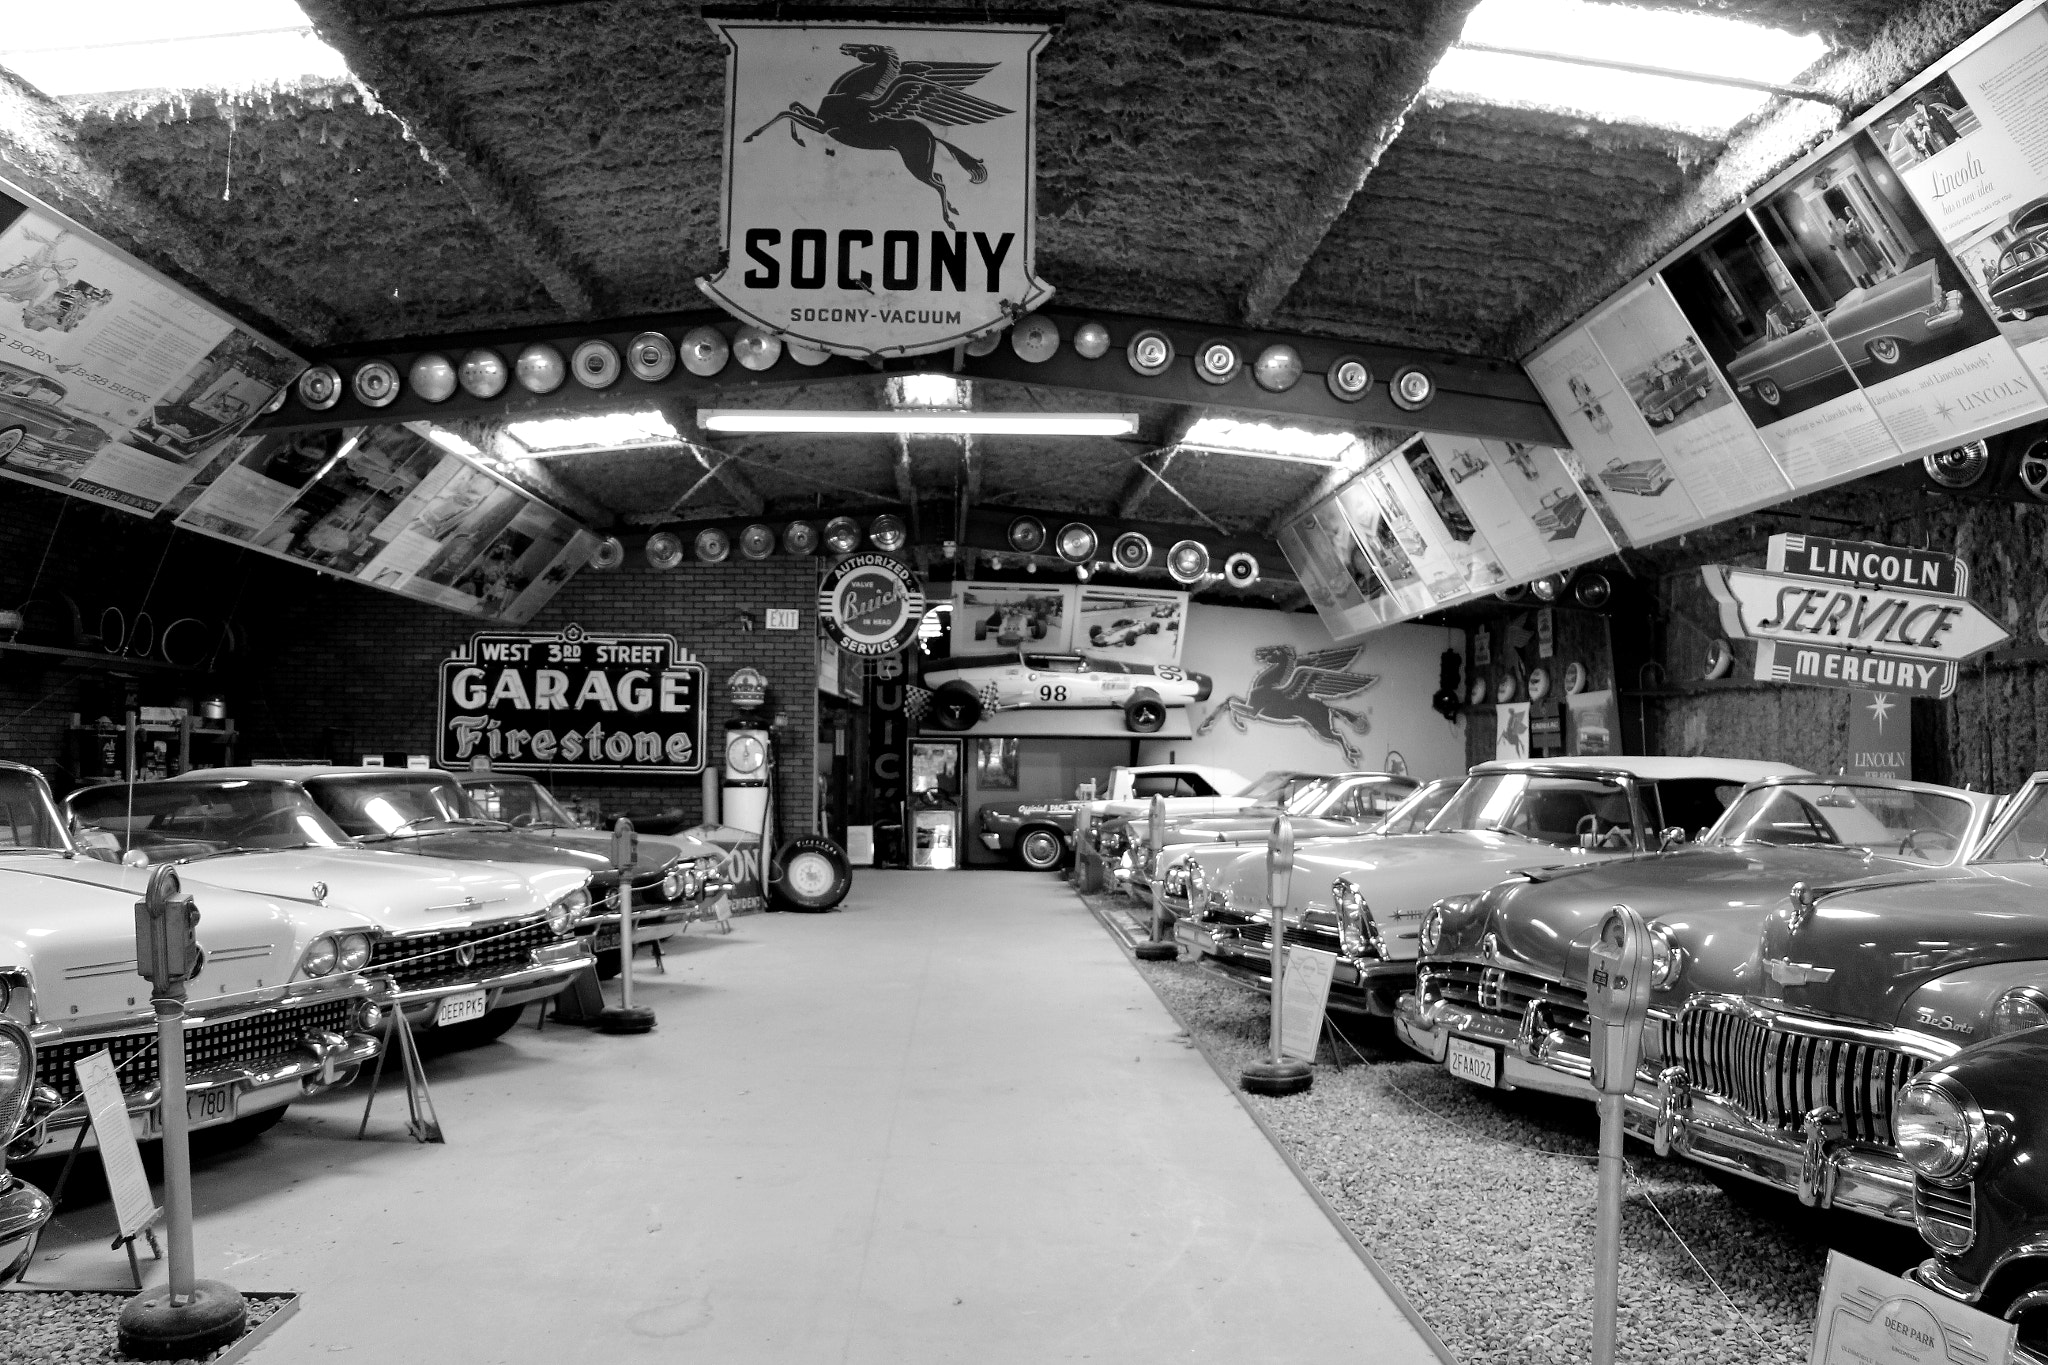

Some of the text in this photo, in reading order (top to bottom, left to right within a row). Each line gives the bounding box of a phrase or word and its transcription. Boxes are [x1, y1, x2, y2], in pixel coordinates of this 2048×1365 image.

[1932, 151, 1985, 200] Lincoln
[1977, 180, 1994, 198] idea
[744, 228, 1015, 293] SOCONY
[790, 308, 961, 325] SOCONY-VACUUM
[8, 339, 59, 364] BORN
[107, 383, 151, 403] BUICK
[1933, 365, 1966, 383] Lincoln
[1957, 377, 2028, 411] LINCOLN
[834, 555, 909, 580] AUTHORIZED
[1809, 546, 1940, 587] LINCOLN
[841, 577, 908, 628] Buick
[771, 611, 798, 628] EXIT
[1757, 586, 1963, 649] SERVICE
[481, 643, 665, 664] WEST 3RD STREET
[840, 636, 899, 654] SERVICE
[1795, 650, 1937, 690] MERCURY
[451, 667, 692, 712] GARAGE
[1040, 685, 1067, 702] 98
[448, 714, 693, 764] Firestone
[1855, 752, 1905, 767] LINCOLN
[442, 997, 484, 1021] DEER PK5
[1453, 1052, 1491, 1081] 2FAA022
[199, 1091, 226, 1117] 780
[1884, 1317, 1935, 1348] DEER PARK
